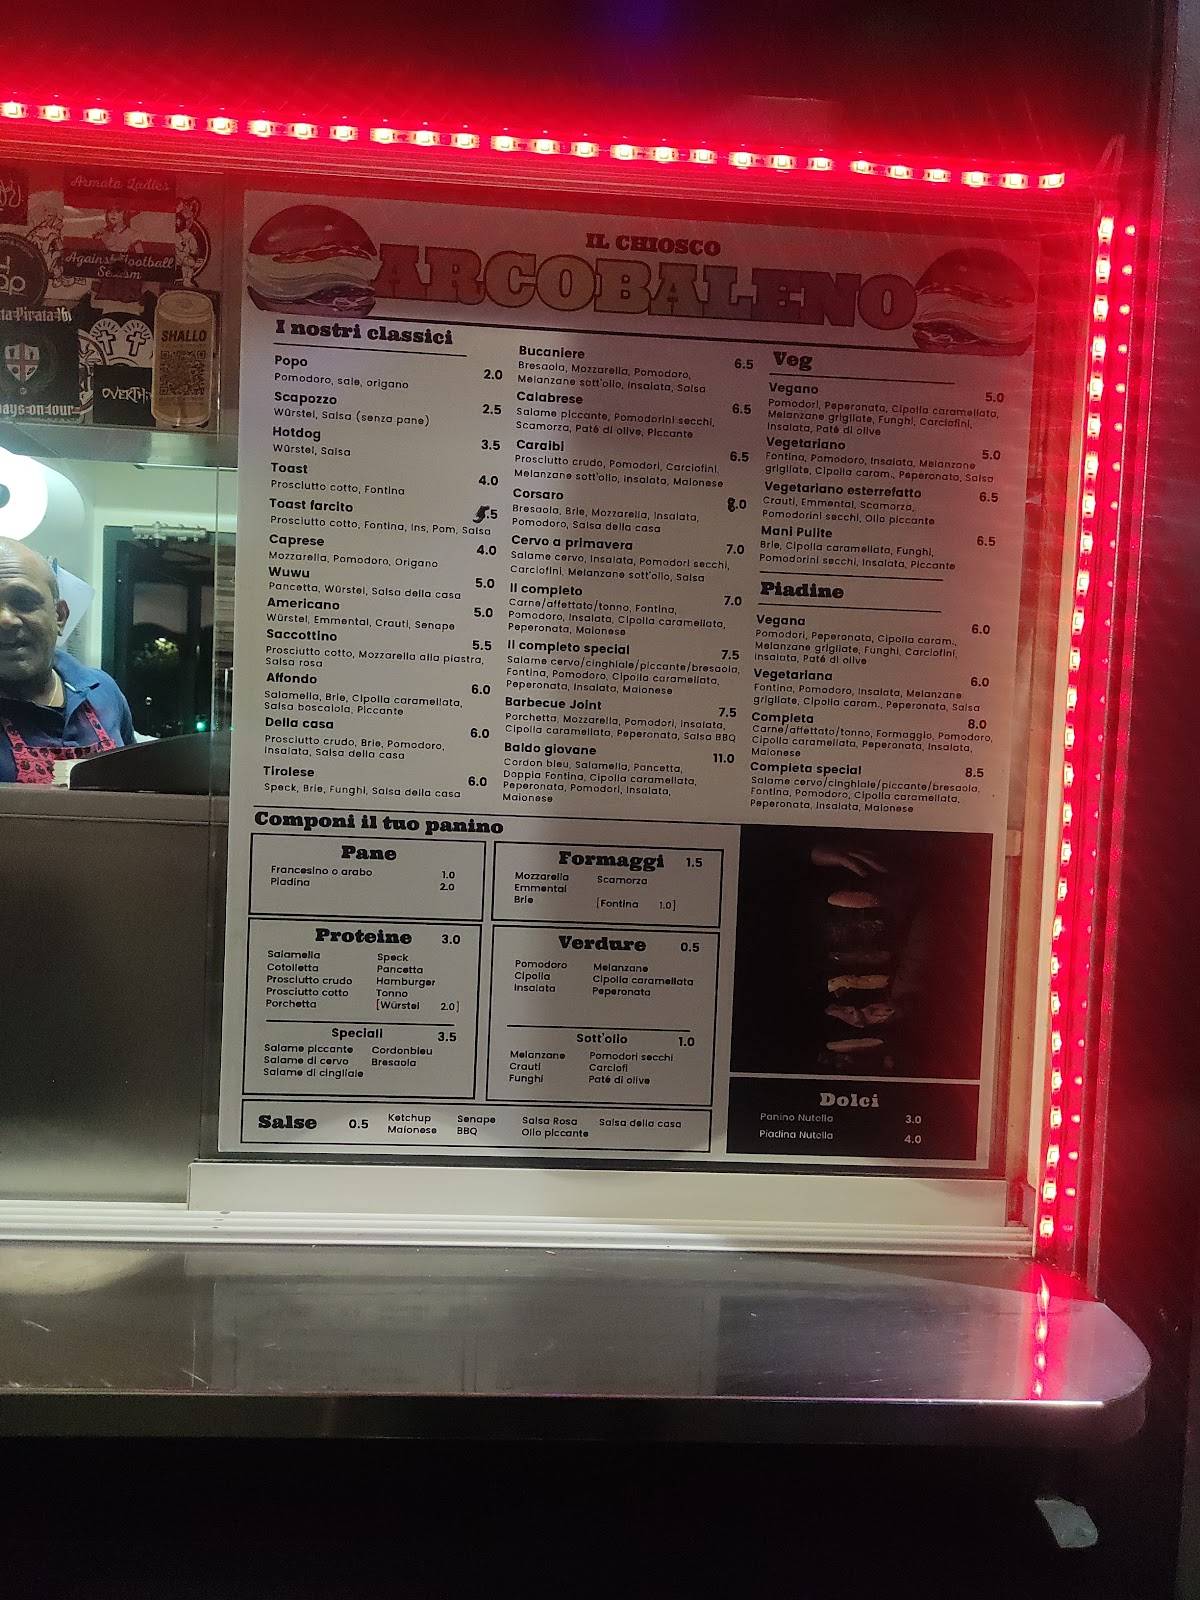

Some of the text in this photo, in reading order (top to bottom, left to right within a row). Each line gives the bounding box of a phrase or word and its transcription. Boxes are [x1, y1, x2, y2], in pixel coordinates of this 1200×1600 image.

[585, 232, 721, 257] IL CHIOSCO
[374, 243, 918, 330] ARCOBALENO
[161, 329, 208, 342] SHALLO
[275, 319, 453, 345] I nostri classici
[519, 345, 585, 359] Bucaniere
[274, 354, 308, 370] Popo
[734, 358, 754, 370] 6.5
[772, 350, 813, 372] Veg
[483, 368, 503, 380] 2.0
[768, 381, 819, 397] Vegano
[274, 391, 337, 407] Scapozzo
[516, 391, 584, 405] Calabrese
[985, 391, 1005, 403] 5.0
[482, 403, 502, 415] 2.5
[731, 402, 752, 415] 6.5
[272, 426, 321, 443] Hotdog
[481, 439, 501, 451] 3.5
[516, 439, 564, 452] Caraibi
[766, 435, 846, 451] Vegetariano
[729, 450, 750, 463] 6.5
[981, 449, 1001, 460] 5.0
[270, 462, 308, 474] Toast
[478, 474, 499, 486] 4.0
[512, 488, 564, 500] Corsaro
[764, 480, 922, 498] Vegetariano esterrefatto
[979, 491, 999, 503] 6.5
[268, 497, 353, 513] Toast farcito
[760, 525, 833, 538] Mani Pulite
[269, 533, 325, 548] Caprese
[511, 534, 633, 551] Cervo a primavera
[976, 535, 996, 547] 6.5
[476, 544, 497, 556] 4.0
[726, 543, 745, 555] 7.0
[268, 566, 310, 578] Wuwu
[475, 577, 495, 589] 5.0
[510, 582, 583, 598] Il completo
[759, 581, 844, 599] Piadine
[266, 597, 340, 610] Americano
[723, 595, 742, 606] 7.0
[473, 607, 493, 618] 5.0
[756, 614, 805, 629] Vegana
[266, 628, 337, 642] Saccottino
[971, 623, 991, 635] 6.0
[472, 639, 492, 651] 5.5
[507, 639, 630, 657] Il completo special
[721, 649, 740, 660] 7.5
[266, 671, 318, 684] Affondo
[753, 668, 833, 682] Vegetariana
[970, 676, 990, 687] 6.0
[471, 683, 491, 695] 6.0
[505, 696, 602, 711] Barbecue Joint
[718, 707, 737, 718] 7.5
[751, 711, 814, 726] Completa
[265, 716, 334, 729] Della casa
[967, 718, 987, 730] 8.0
[470, 727, 490, 739] 6.0
[504, 742, 597, 757] Baldo giovane
[712, 752, 735, 764] 11.0
[263, 765, 315, 777] Tirolese
[750, 761, 862, 777] Completa special
[965, 767, 984, 778] 8.5
[467, 775, 487, 787] 6.0
[254, 811, 504, 836] Componi il tuo panino
[341, 845, 397, 861] Pane
[558, 850, 665, 872] Formaggi
[686, 857, 703, 868] 1.5
[271, 865, 373, 877] Francesino o arabo
[441, 870, 456, 879] 1.0
[270, 876, 310, 887] Piadina
[439, 882, 455, 891] 2.0
[314, 927, 413, 945] Proteine
[441, 933, 461, 945] 3.0
[558, 935, 647, 952] Verdure
[680, 941, 700, 953] 0.5
[267, 949, 321, 959] Salamella
[377, 952, 409, 964] Speck
[376, 964, 423, 974] Pancetta
[266, 974, 353, 985] Prosciutto crudo
[376, 976, 436, 989] Hamburger
[266, 986, 349, 997] Prosciutto cotto
[375, 988, 408, 998] Tonno
[265, 998, 317, 1008] Porchetta
[331, 1027, 383, 1041] Speciali
[437, 1031, 457, 1042] 3.5
[576, 1032, 628, 1044] Sott'olio
[678, 1036, 695, 1047] 1.0
[819, 1092, 880, 1108] Dolci
[257, 1114, 317, 1130] Salse
[348, 1118, 369, 1129] 0.5
[760, 1112, 834, 1123] Panino Nutella
[905, 1114, 922, 1125] 3.0
[759, 1129, 834, 1140] Piadina Nutella
[904, 1134, 922, 1144] 4.0
